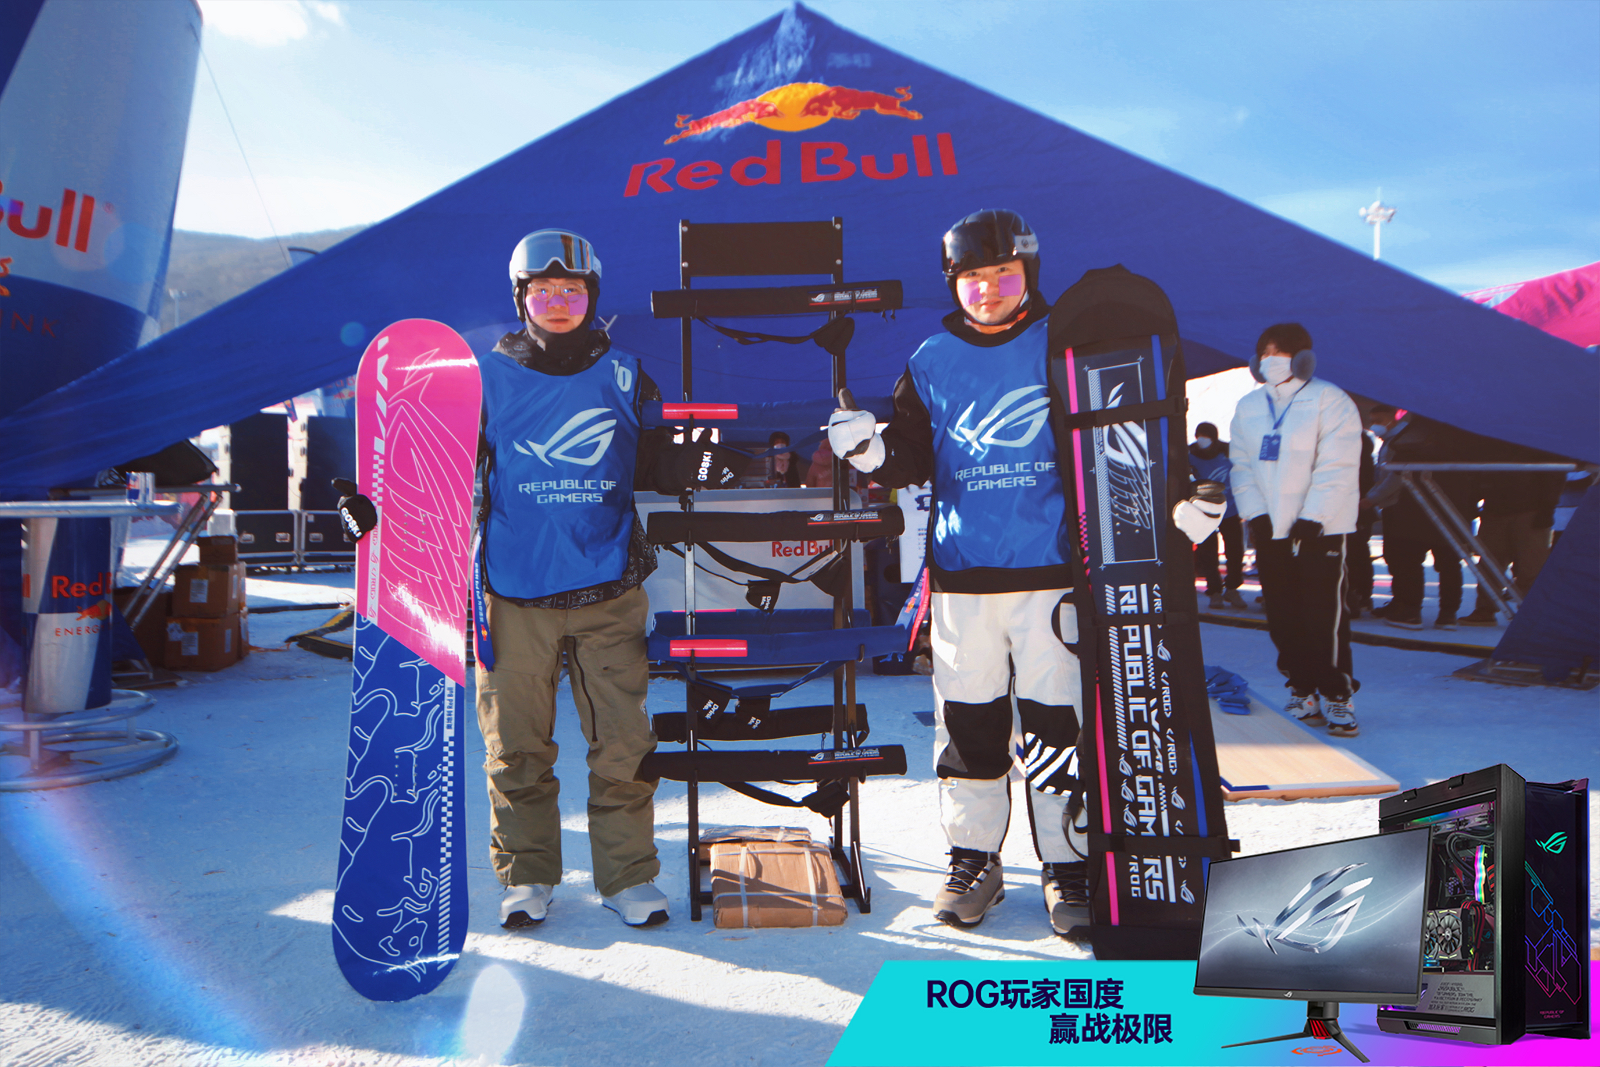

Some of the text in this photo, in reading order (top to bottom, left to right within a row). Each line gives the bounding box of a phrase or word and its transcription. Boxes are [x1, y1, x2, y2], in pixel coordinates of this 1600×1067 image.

[623, 132, 959, 198] Red Bull
[0, 179, 96, 254] ull
[955, 461, 1056, 482] REPUBLIC OF
[966, 475, 1037, 492] GAMERS
[518, 479, 617, 495] REPUBLIC OF
[536, 492, 603, 504] GAMERS
[340, 506, 362, 538] GOSKI
[771, 540, 804, 558] Red
[51, 572, 104, 599] Red
[1160, 671, 1172, 718] </ROG>
[1118, 584, 1165, 902] REPUBLIC OF GAMRS
[1166, 727, 1178, 775] </ROG>
